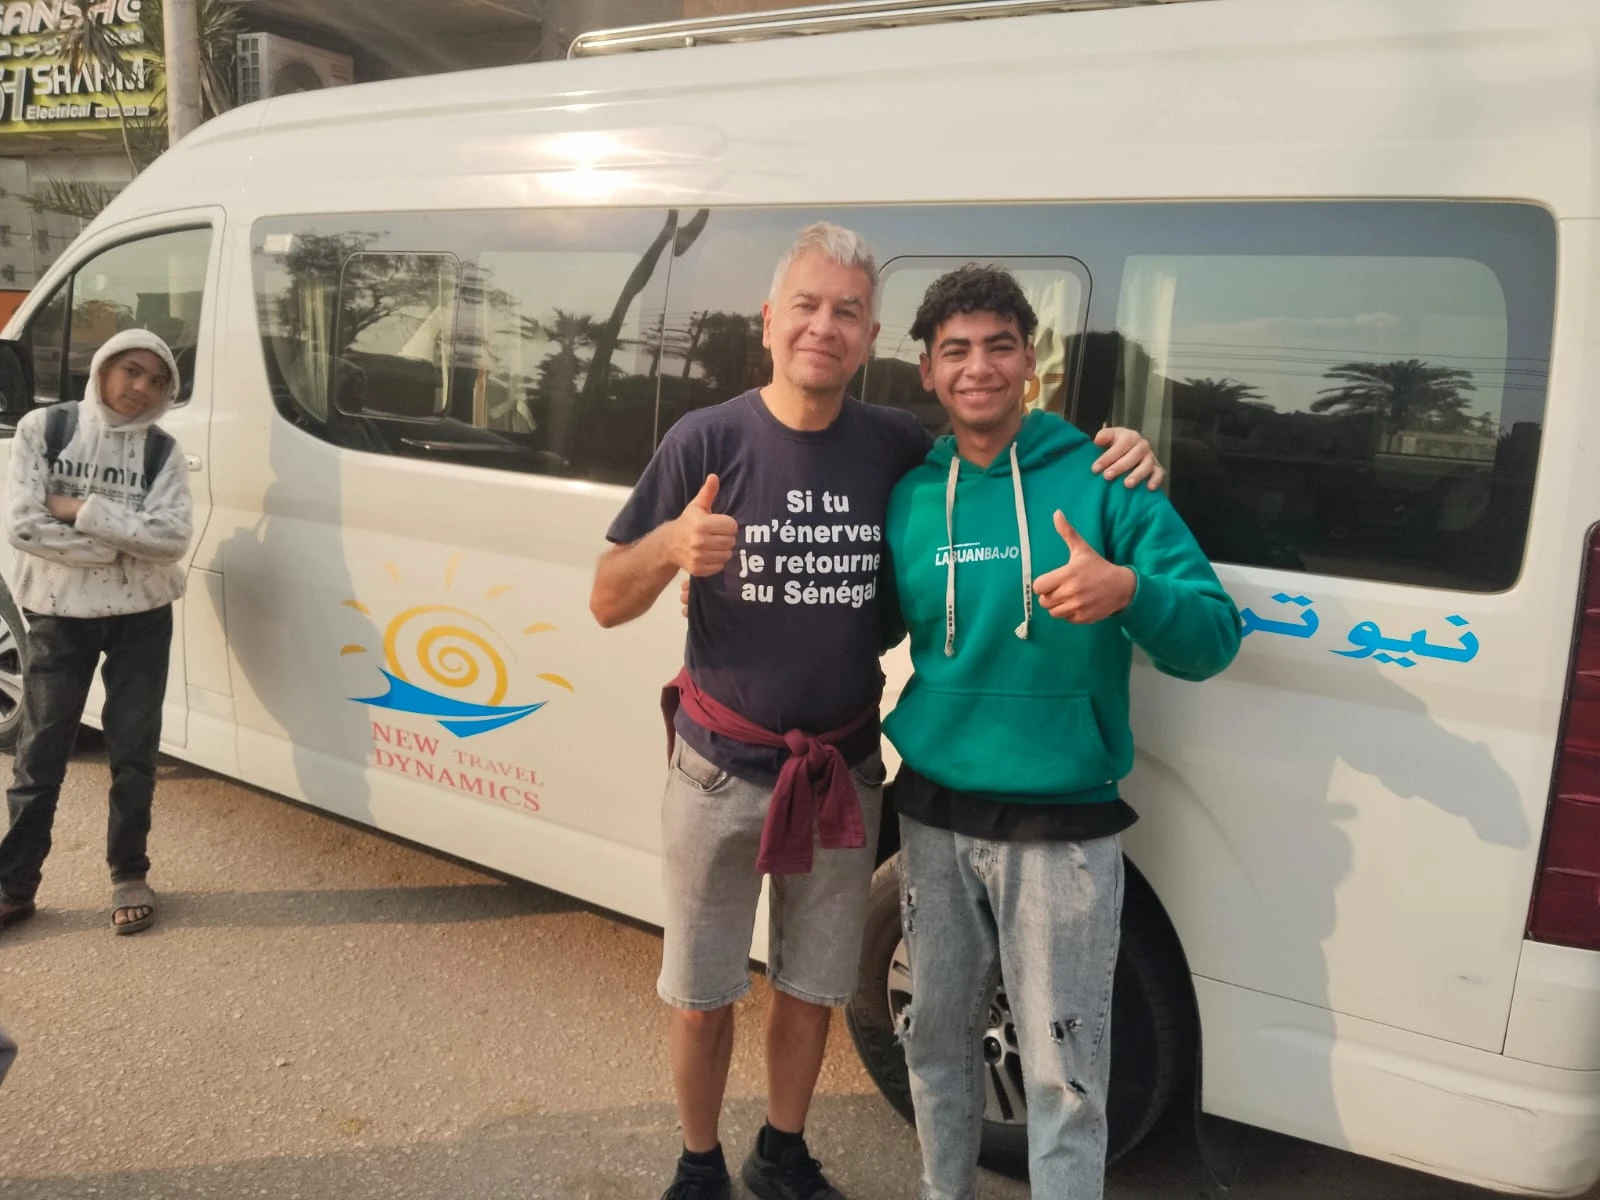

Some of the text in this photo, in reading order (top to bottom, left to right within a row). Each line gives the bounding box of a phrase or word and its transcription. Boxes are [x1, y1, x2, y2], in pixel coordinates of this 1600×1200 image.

[26, 103, 91, 120] Electrical
[786, 489, 849, 513] Si tu
[739, 549, 880, 578] je retourne
[741, 577, 876, 608] au Sénégal
[1328, 615, 1479, 668] نيو
[372, 722, 544, 786] NEW TRAVEL
[375, 748, 540, 812] DYNAMICS
